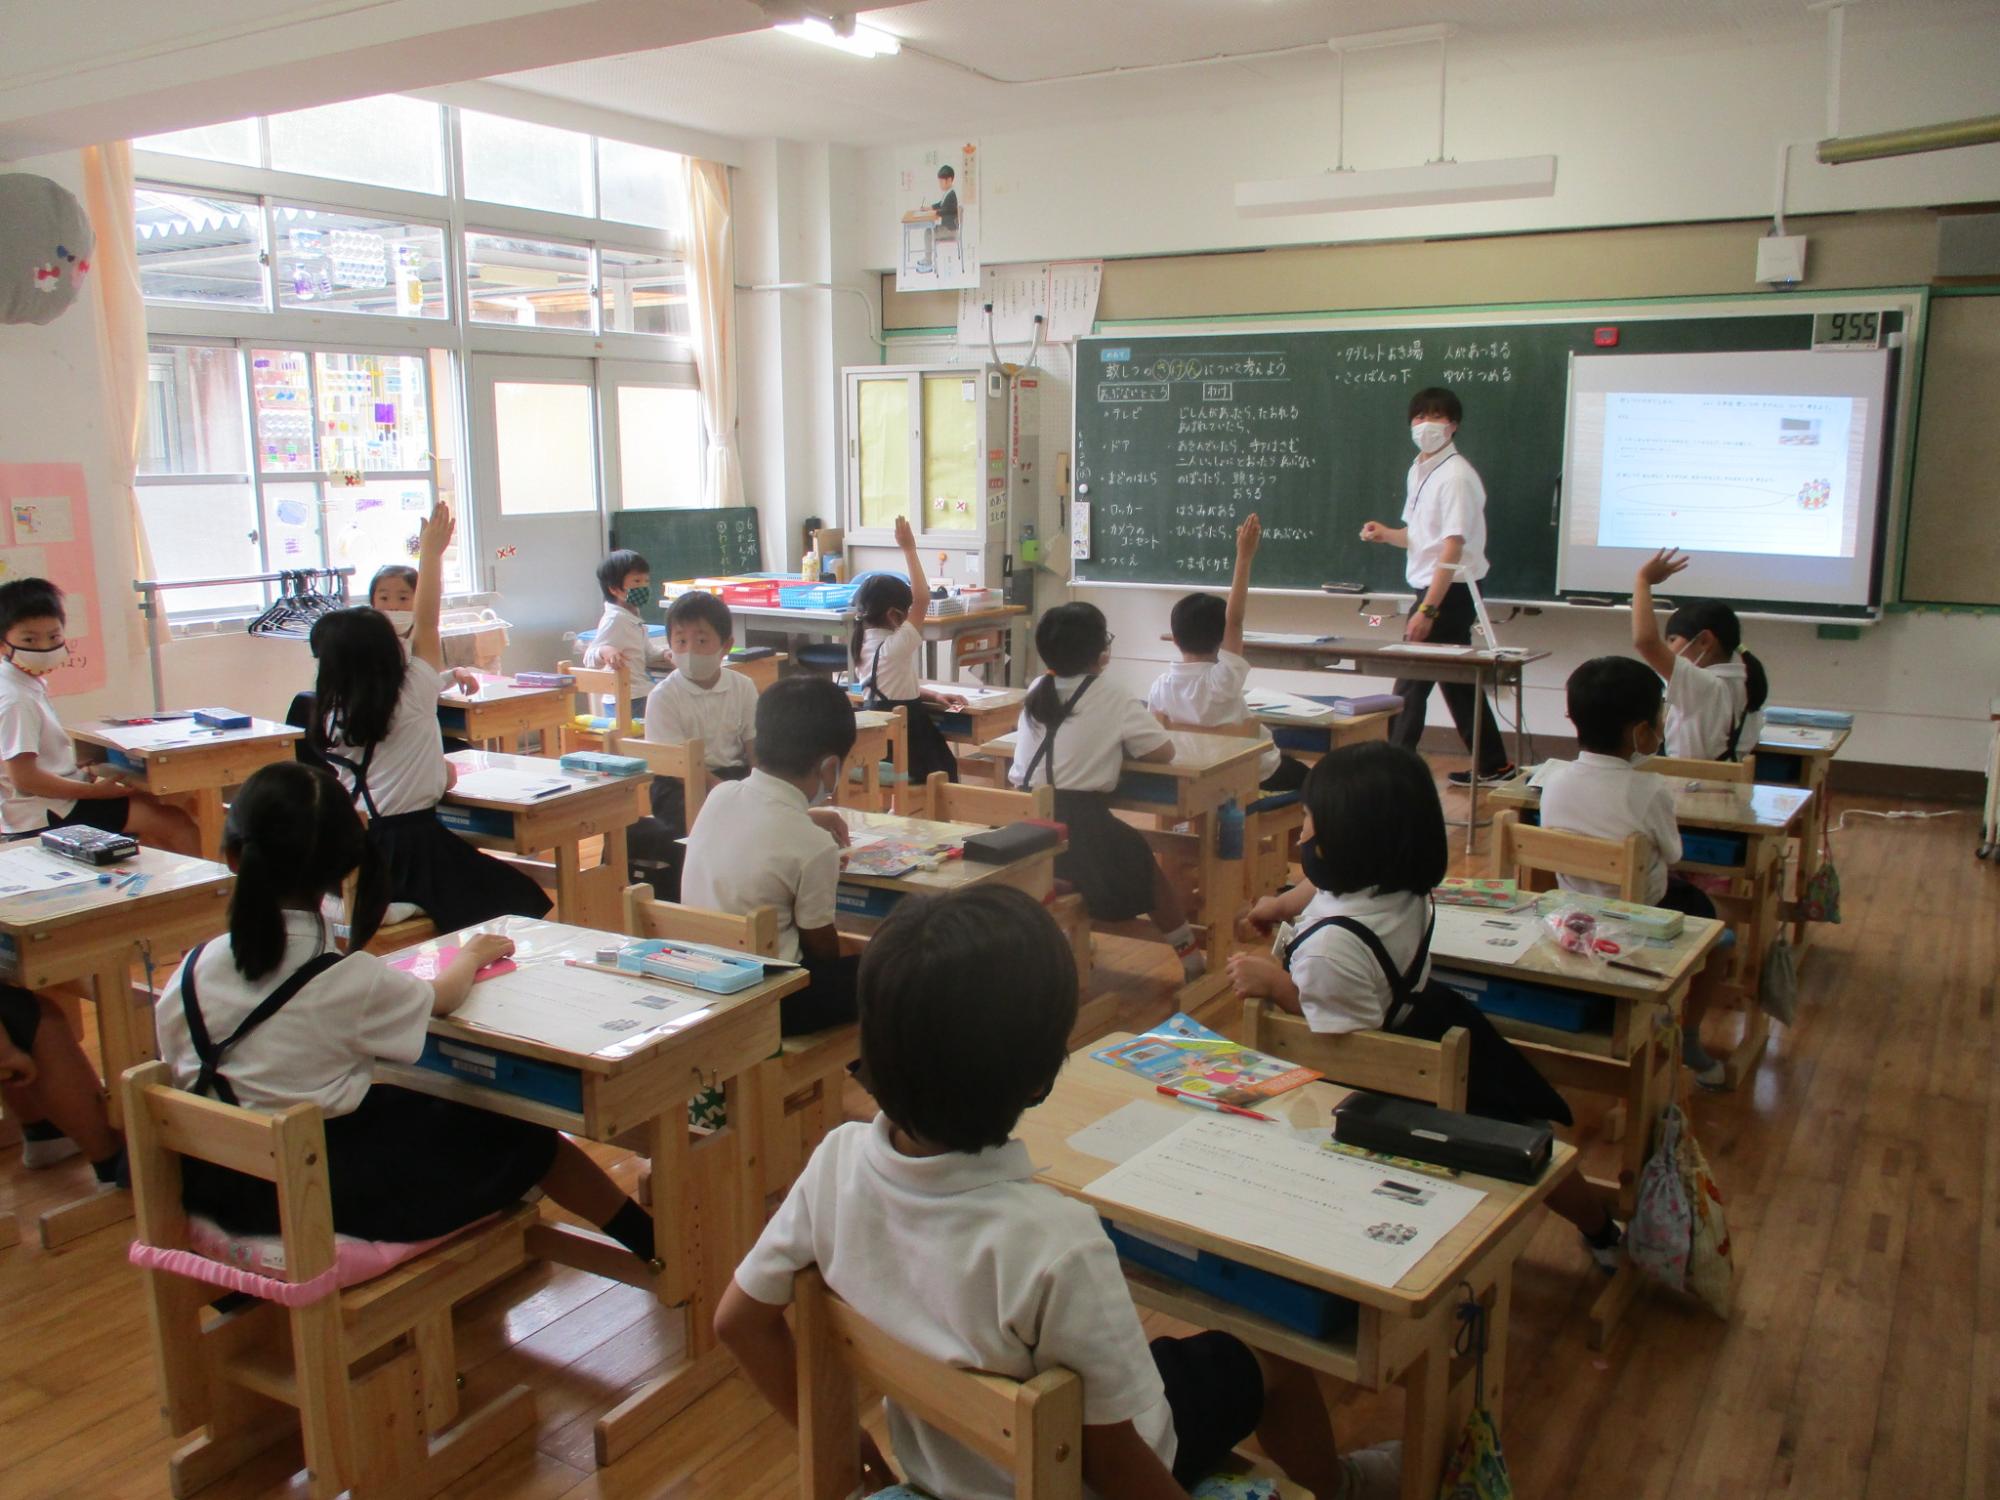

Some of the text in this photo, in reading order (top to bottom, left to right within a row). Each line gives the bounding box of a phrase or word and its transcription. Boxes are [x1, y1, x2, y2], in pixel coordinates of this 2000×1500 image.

[1443, 341, 1511, 361] 人があつまる
[1100, 386, 1168, 400] あぶないところ
[1206, 385, 1227, 398] わけ
[1113, 406, 1143, 420] テレビ
[1111, 440, 1130, 453] ドア
[1232, 487, 1262, 500] おちる
[1111, 503, 1144, 516] ロッカー
[1176, 503, 1236, 518] はさみがある
[1110, 523, 1145, 537] カメラの
[1121, 535, 1160, 549] コンセント
[1110, 553, 1138, 567] つくえ
